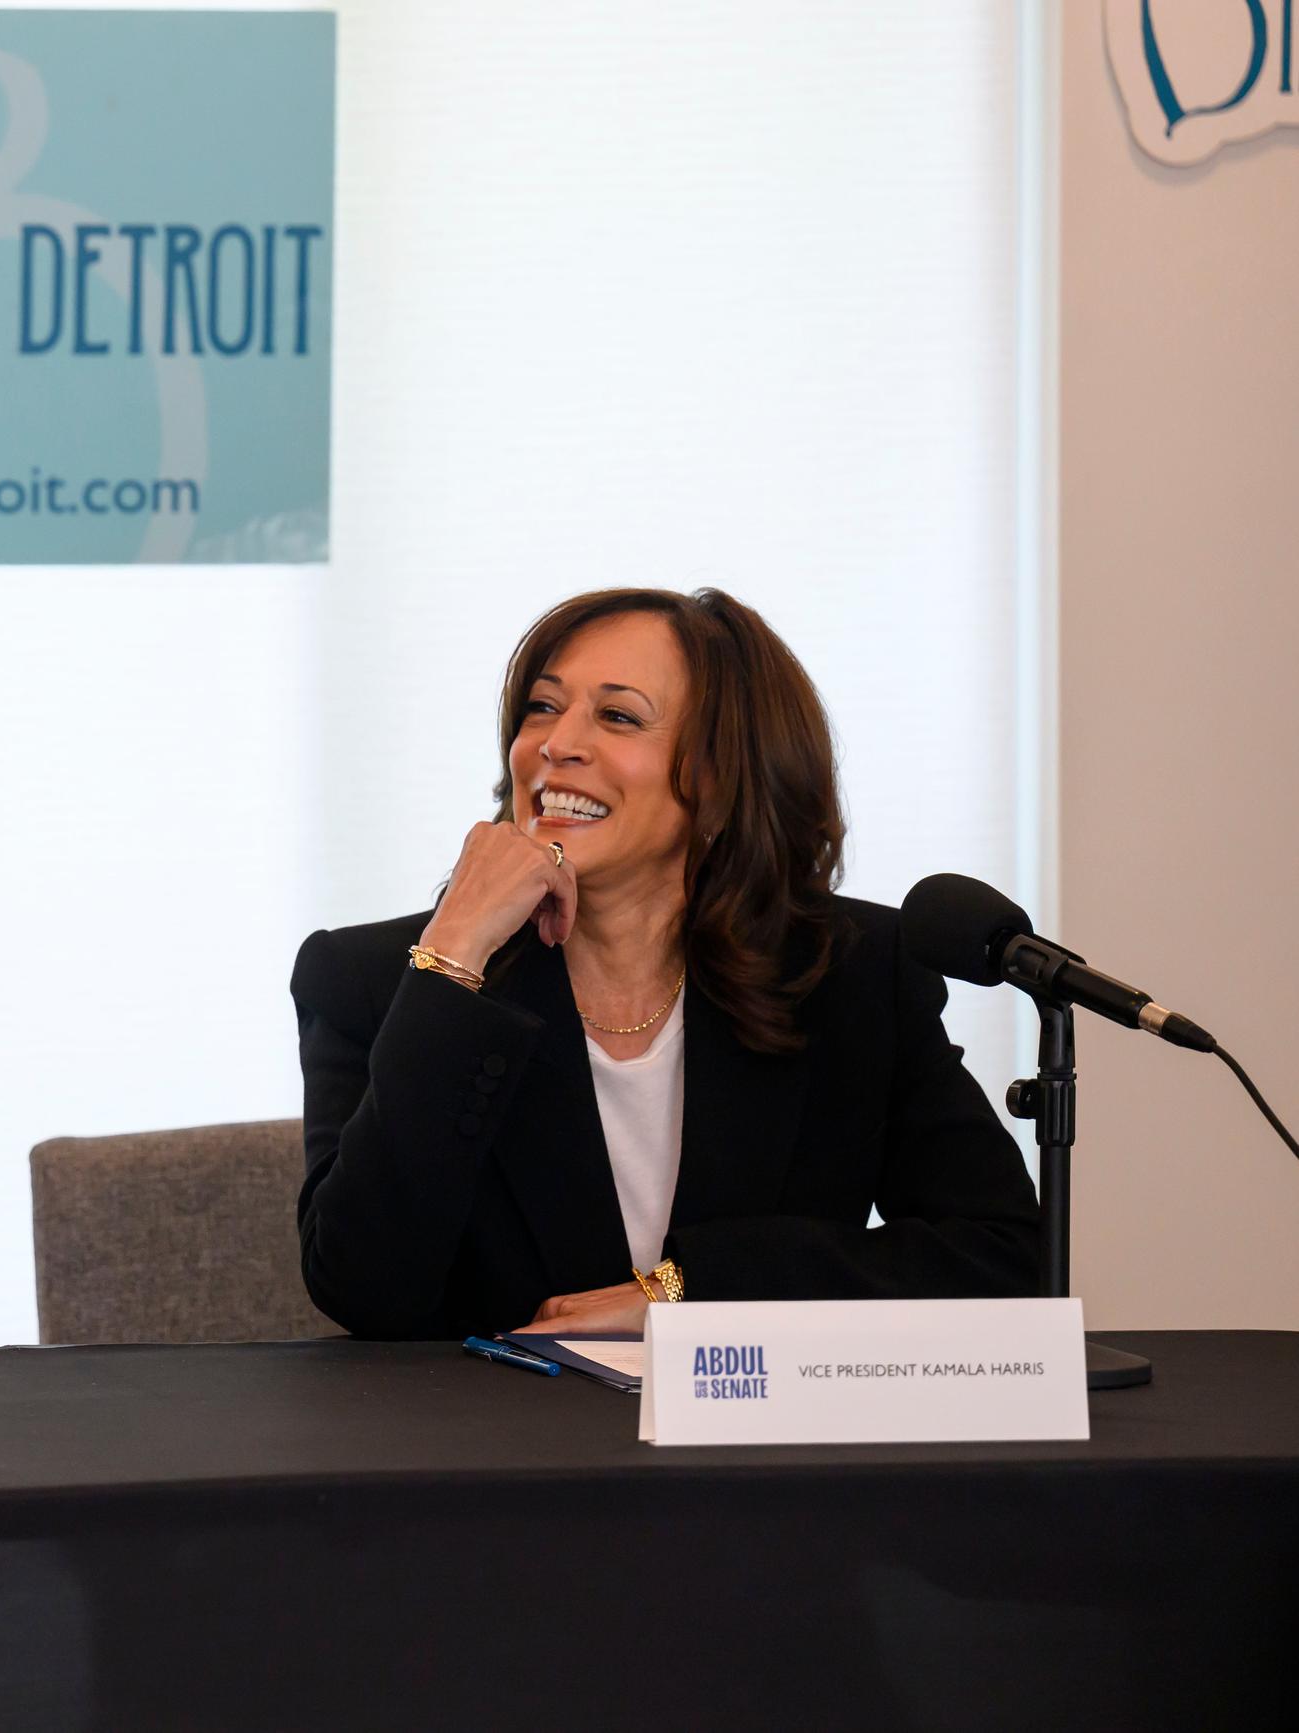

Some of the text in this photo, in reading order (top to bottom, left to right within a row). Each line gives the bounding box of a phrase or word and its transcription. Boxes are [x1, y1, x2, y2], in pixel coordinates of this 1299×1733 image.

[19, 223, 324, 358] DETROIT
[693, 1345, 769, 1376] ABDUL
[798, 1362, 1045, 1378] VICE PRESIDENT KAMALA HARRIS
[711, 1378, 769, 1400] SENATE
